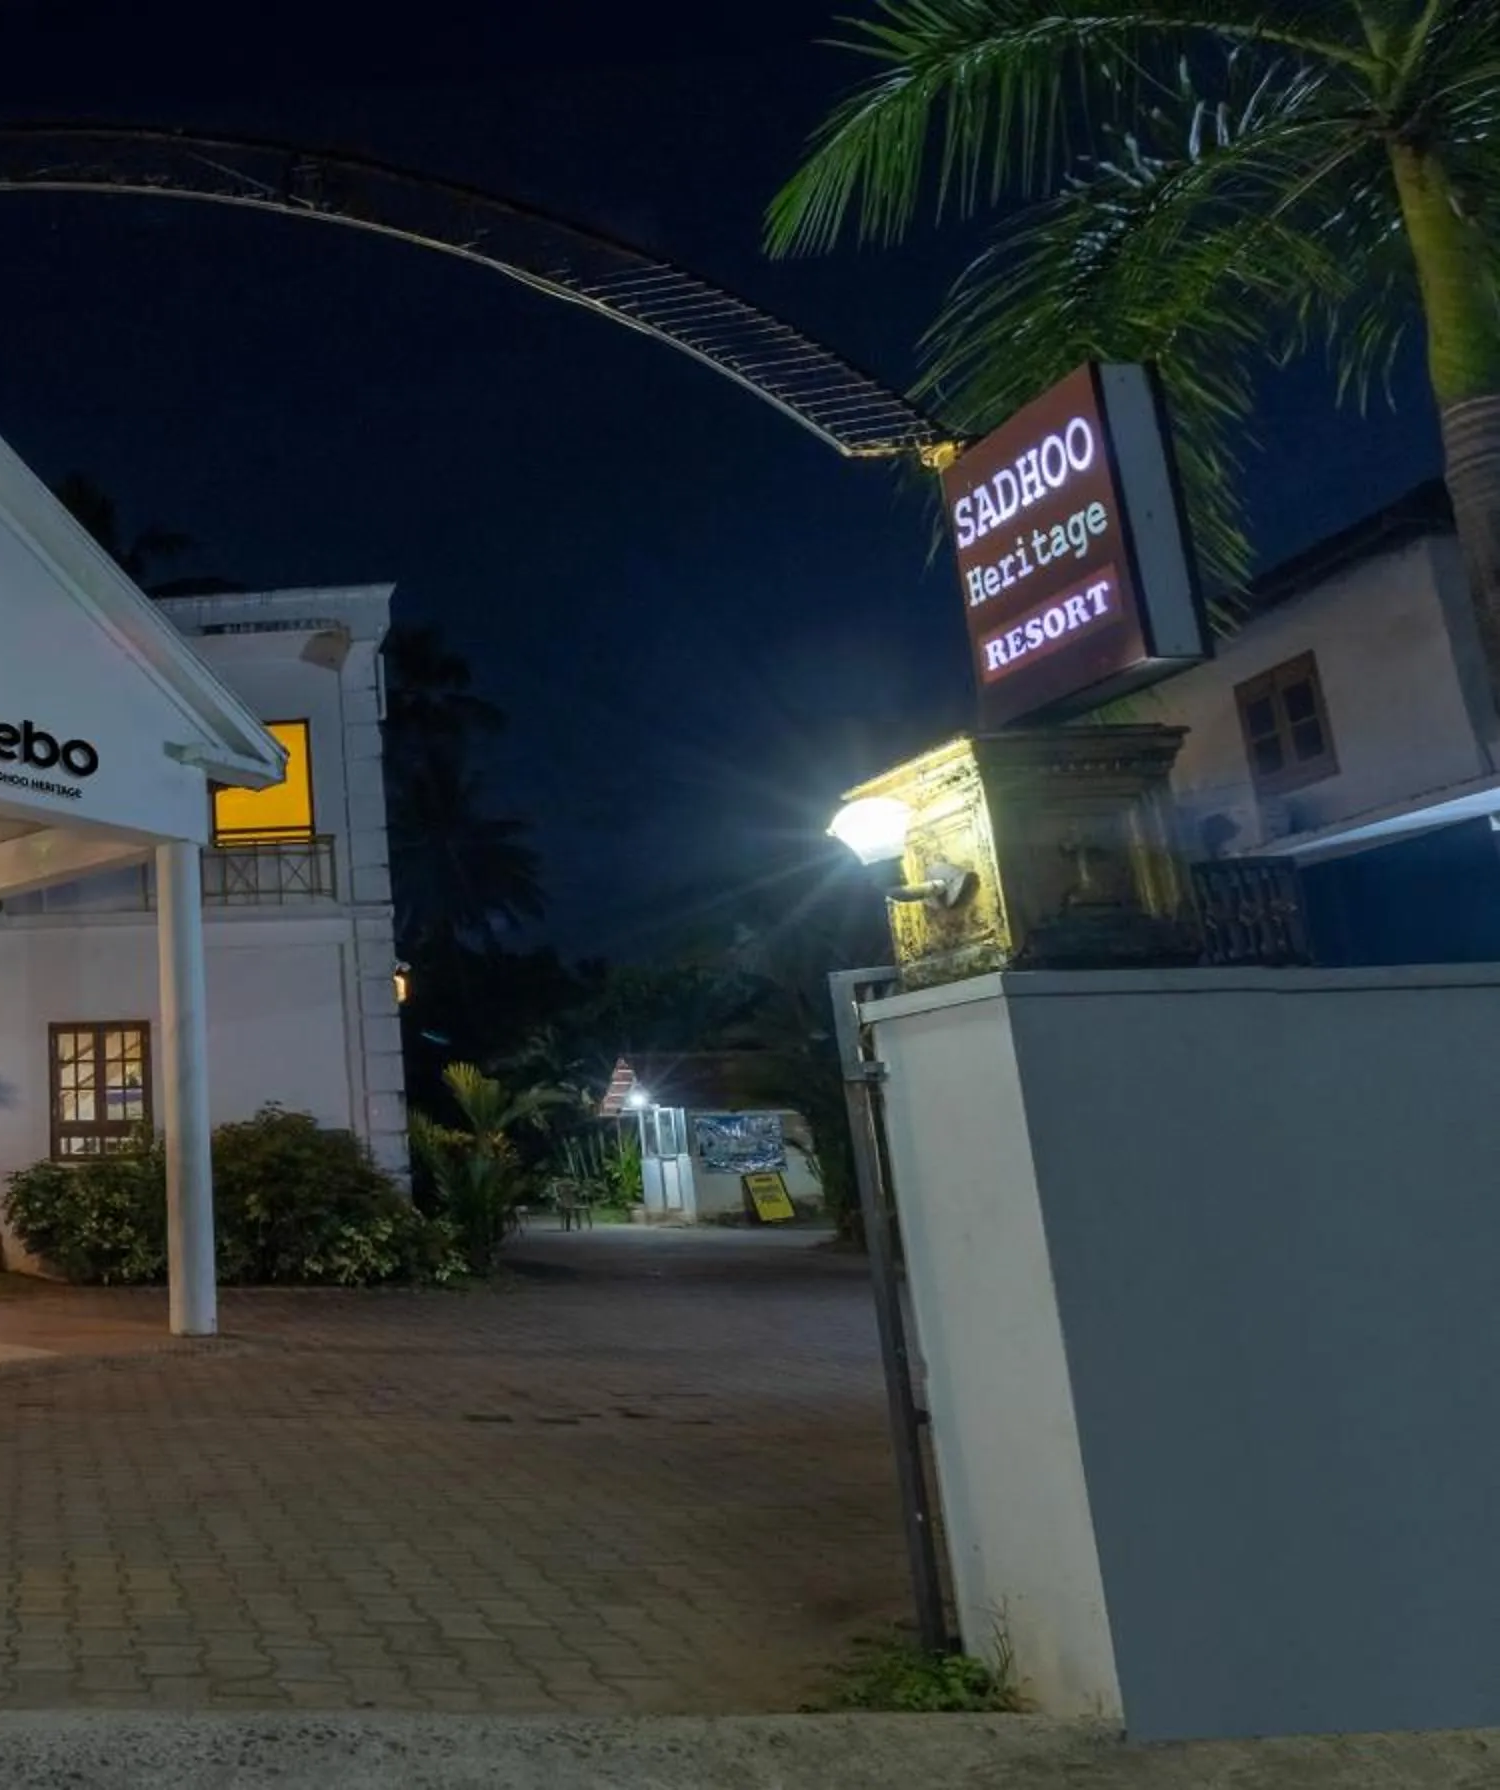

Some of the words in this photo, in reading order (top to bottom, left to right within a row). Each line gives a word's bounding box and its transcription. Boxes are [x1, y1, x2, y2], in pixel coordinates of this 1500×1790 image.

[954, 417, 1094, 549] SADHOO
[965, 501, 1109, 607] Heritage
[984, 581, 1111, 671] RESORT
[31, 777, 83, 799] HERITAGE
